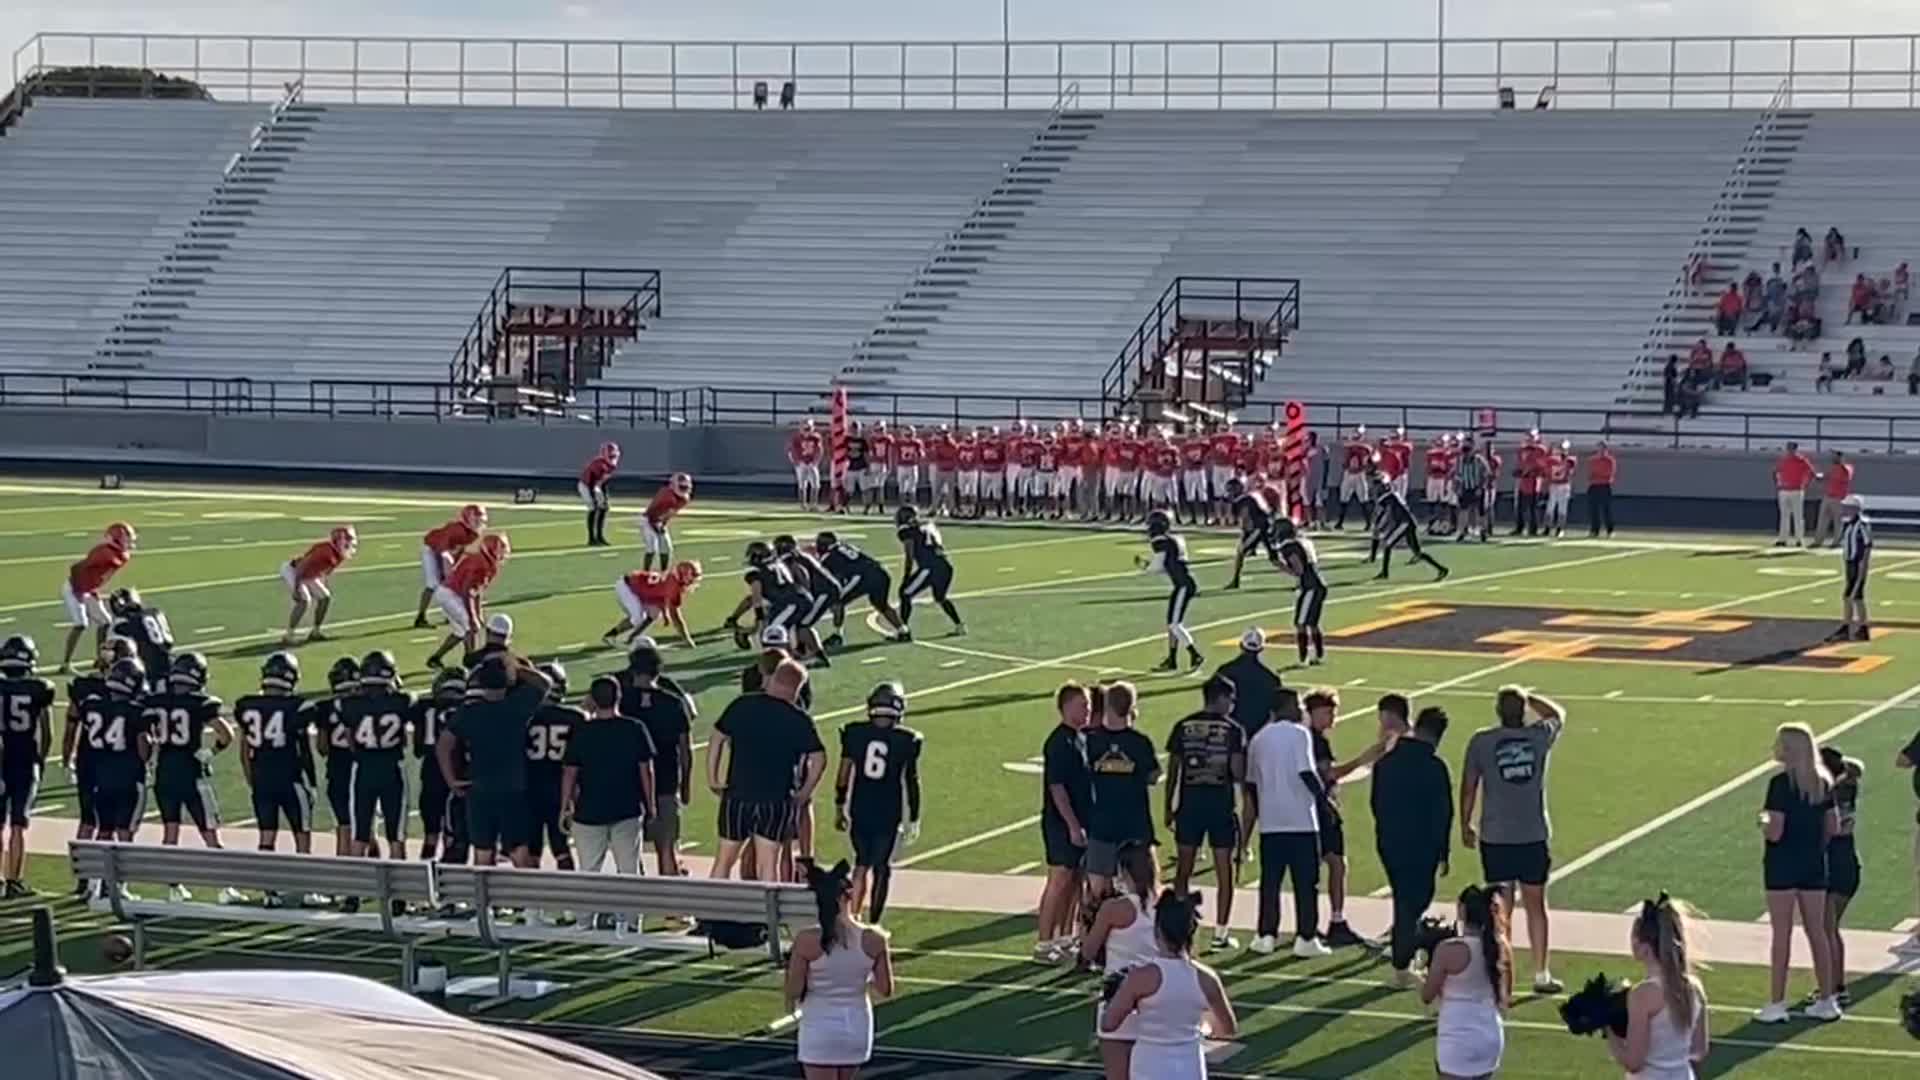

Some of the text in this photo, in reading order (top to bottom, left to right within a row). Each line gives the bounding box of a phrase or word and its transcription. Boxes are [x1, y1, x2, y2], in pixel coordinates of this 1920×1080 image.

[85, 711, 127, 751] 24
[143, 707, 191, 746] 33
[243, 709, 286, 748] 34
[355, 712, 401, 749] 42
[527, 725, 570, 760] 35
[864, 740, 889, 779] 6
